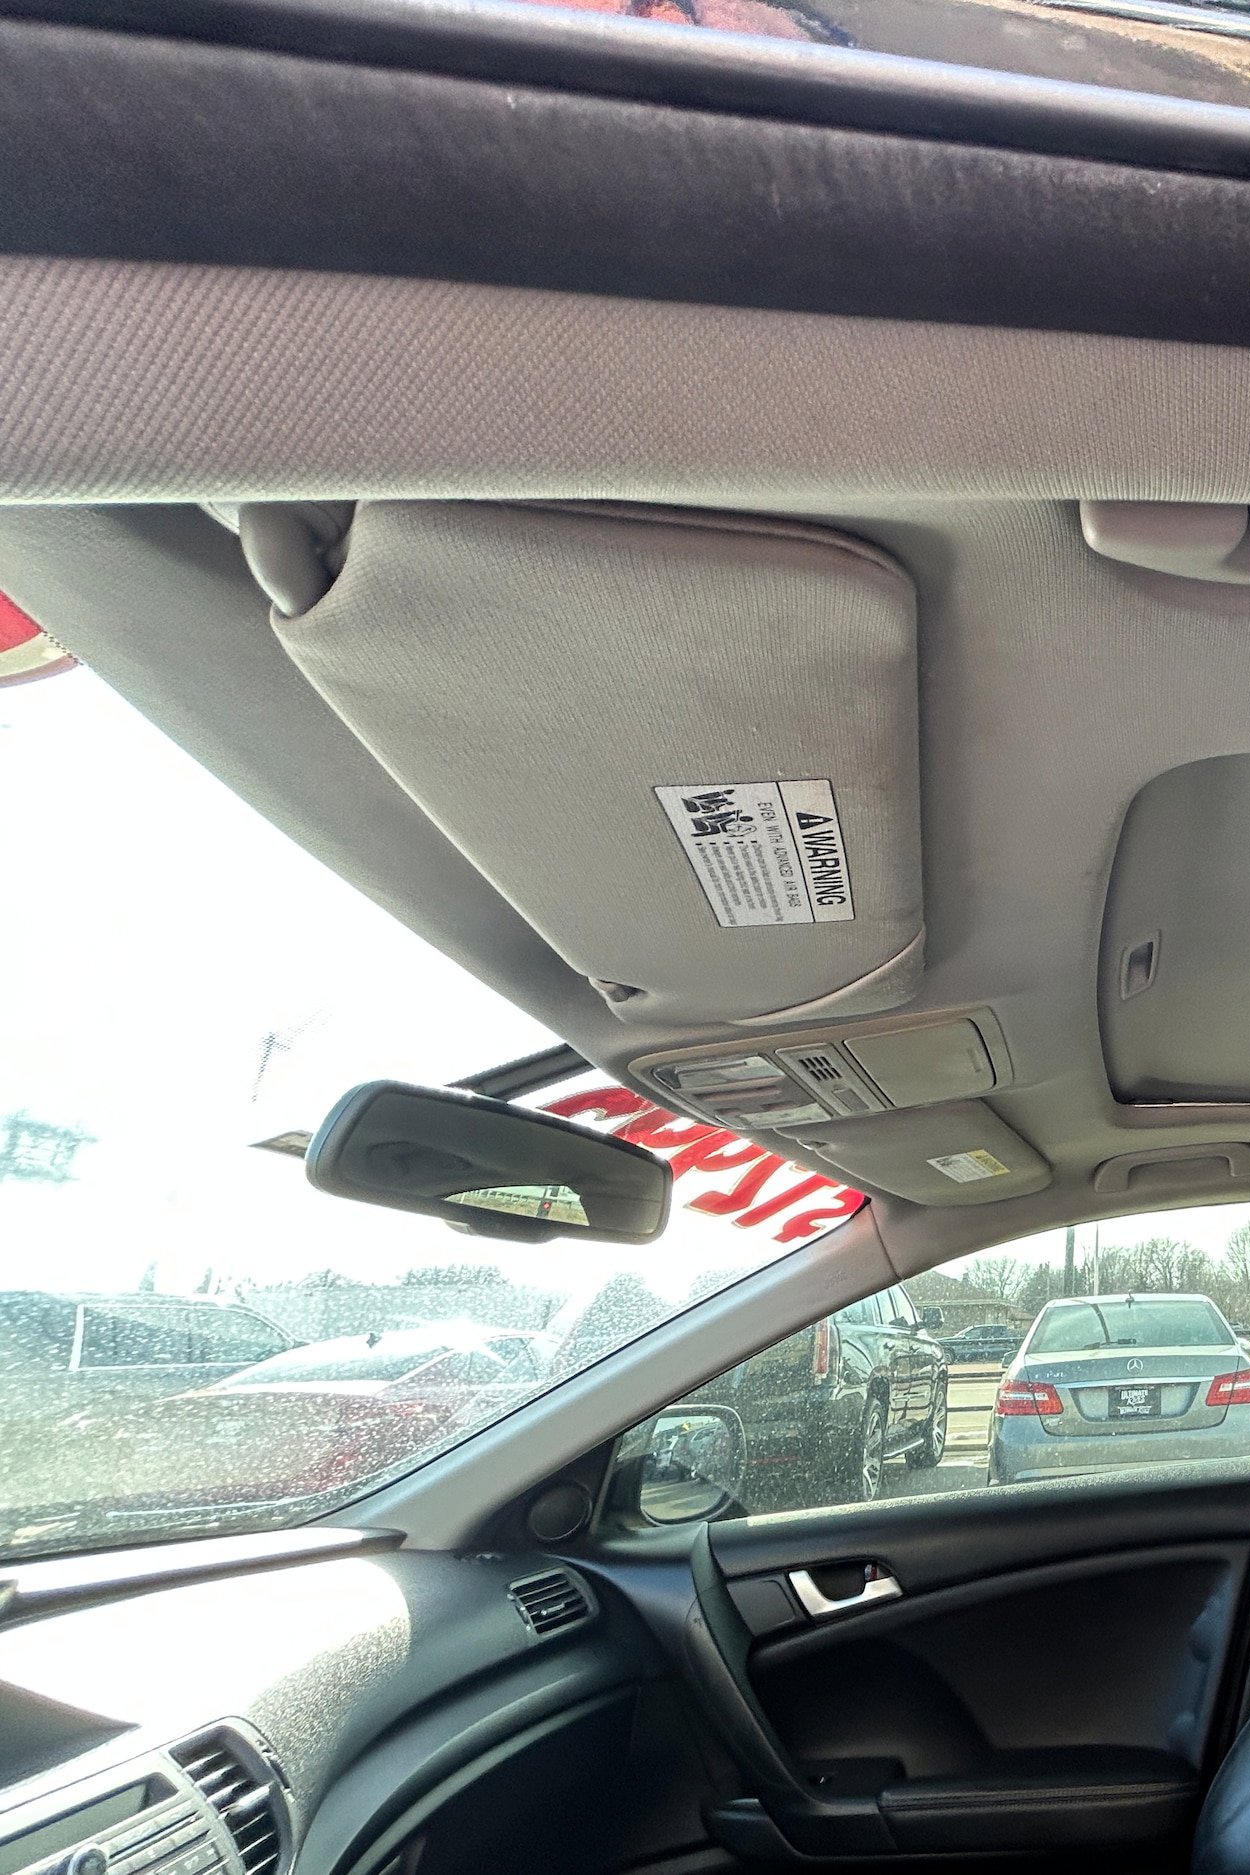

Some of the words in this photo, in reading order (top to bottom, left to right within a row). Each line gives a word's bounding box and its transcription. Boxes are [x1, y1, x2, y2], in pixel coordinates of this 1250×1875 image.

[757, 802, 777, 822] EVEN
[766, 825, 784, 844] WITH
[774, 846, 794, 878] ADVANCED
[801, 830, 846, 906] WARNING
[784, 880, 798, 891] AIR
[787, 893, 802, 908] BAGS
